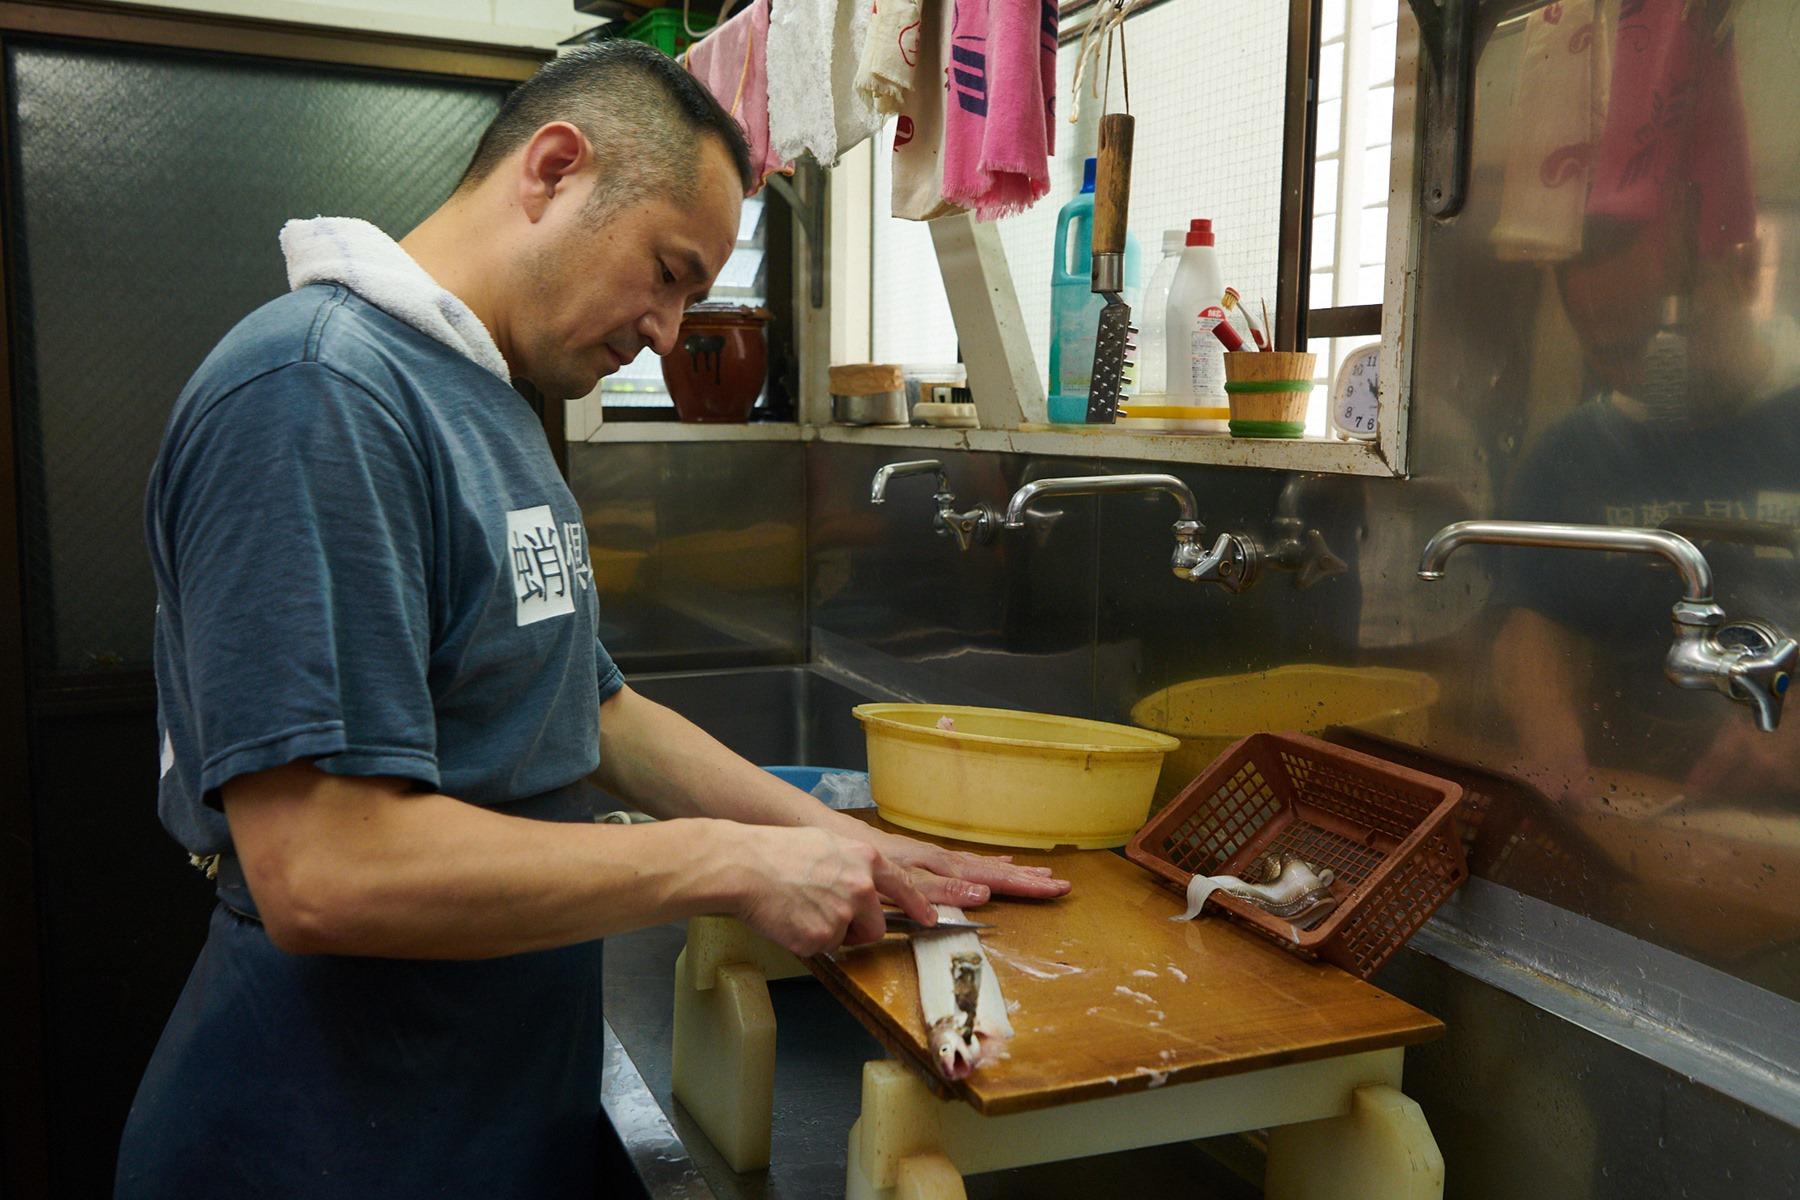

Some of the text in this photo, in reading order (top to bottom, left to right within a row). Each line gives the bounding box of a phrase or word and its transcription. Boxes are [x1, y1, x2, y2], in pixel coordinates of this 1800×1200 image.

[1366, 355, 1377, 367] 11
[1352, 363, 1364, 376] 10
[1346, 385, 1354, 397] 9
[1344, 406, 1353, 418] 8
[1355, 416, 1363, 428] 7
[1367, 418, 1375, 430] 6
